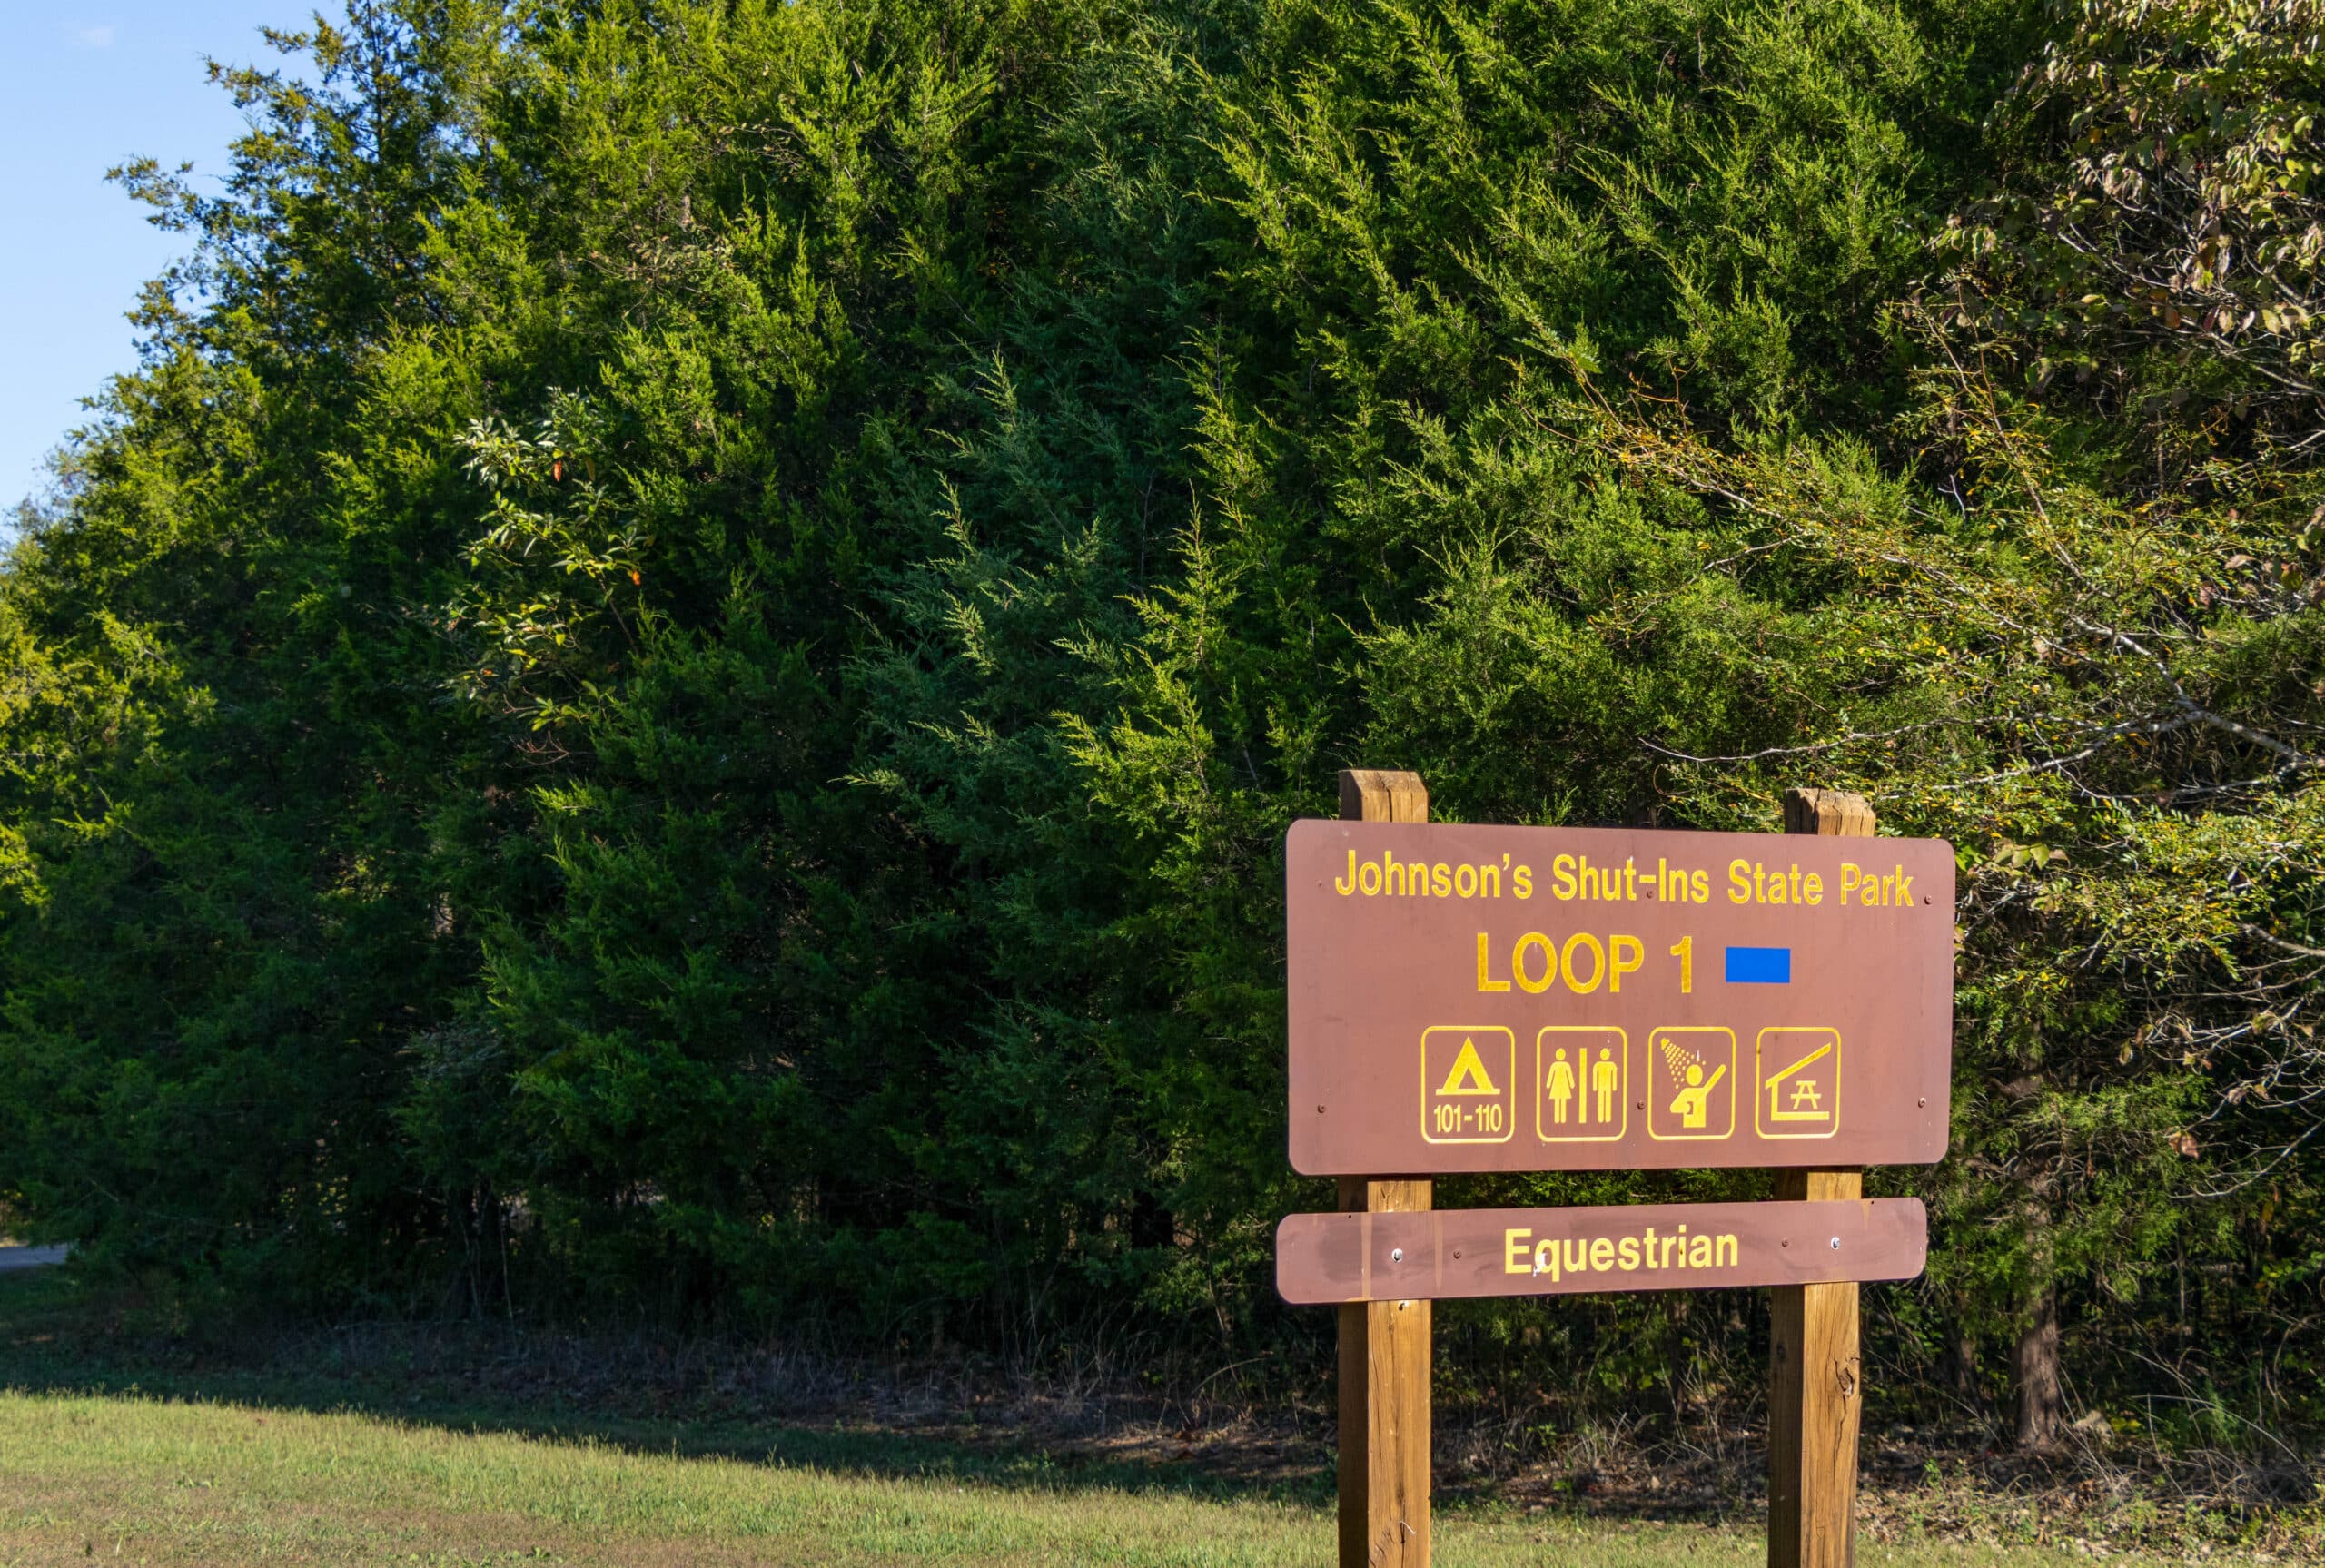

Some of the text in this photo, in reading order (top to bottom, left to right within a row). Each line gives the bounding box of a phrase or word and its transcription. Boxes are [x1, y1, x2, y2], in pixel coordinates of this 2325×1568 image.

[1335, 849, 1914, 907] Johnson's Shut-Ins State Park
[1477, 932, 1693, 994] LOOP 1
[1433, 1103, 1503, 1133] 101-110
[1505, 1224, 1738, 1282] Equestrian
